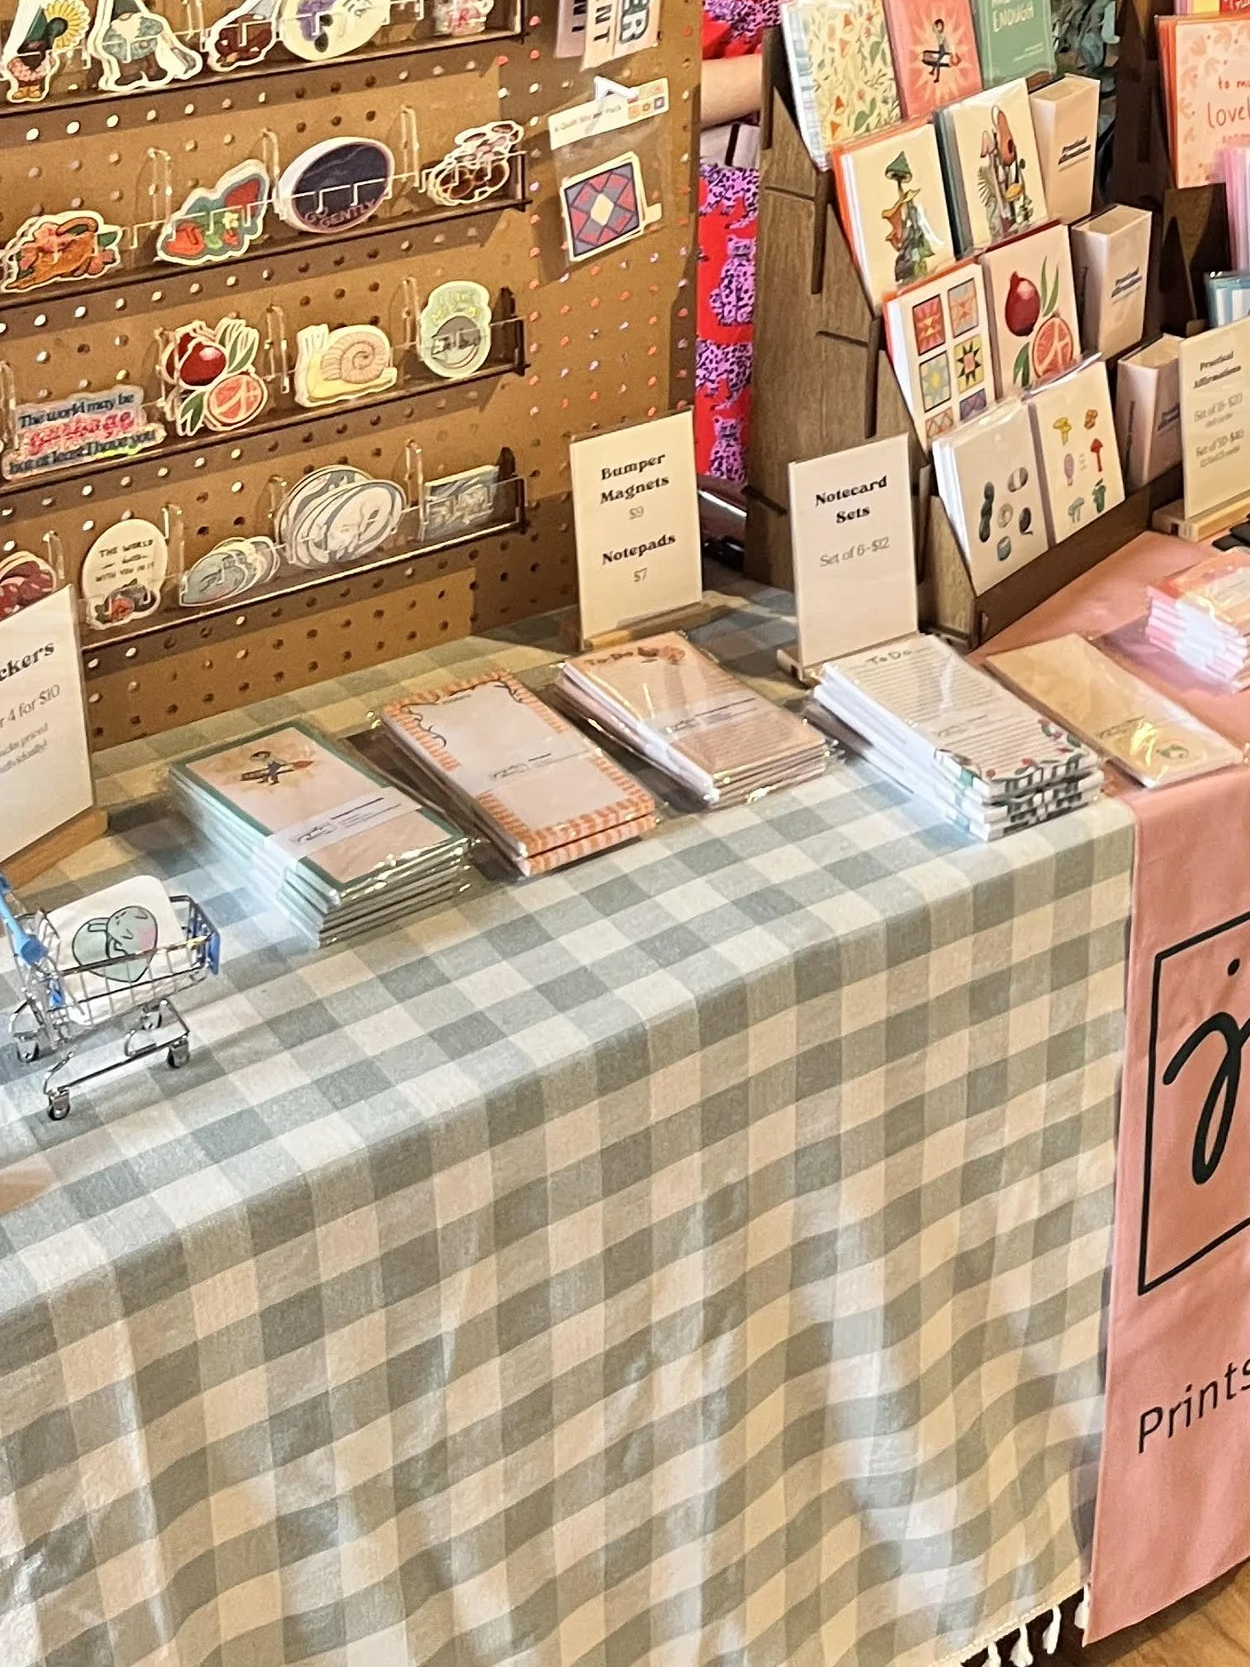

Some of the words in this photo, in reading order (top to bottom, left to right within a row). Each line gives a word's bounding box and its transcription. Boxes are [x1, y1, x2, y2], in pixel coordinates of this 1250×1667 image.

[1218, 75, 1230, 90] to
[319, 198, 376, 228] GENTLY
[18, 413, 45, 428] The
[118, 393, 135, 405] be
[601, 454, 666, 481] Bumper
[600, 476, 670, 504] Magnets
[815, 475, 887, 508] Notecard
[836, 506, 870, 524] Sets
[98, 547, 118, 558] THE
[602, 533, 677, 565] Notepads
[819, 553, 840, 568] Set
[842, 545, 856, 561] of
[0, 641, 56, 681] ckers
[867, 655, 888, 665] To
[888, 649, 912, 660] Do
[7, 708, 17, 722] 4
[18, 697, 38, 718] for
[39, 684, 61, 705] $10
